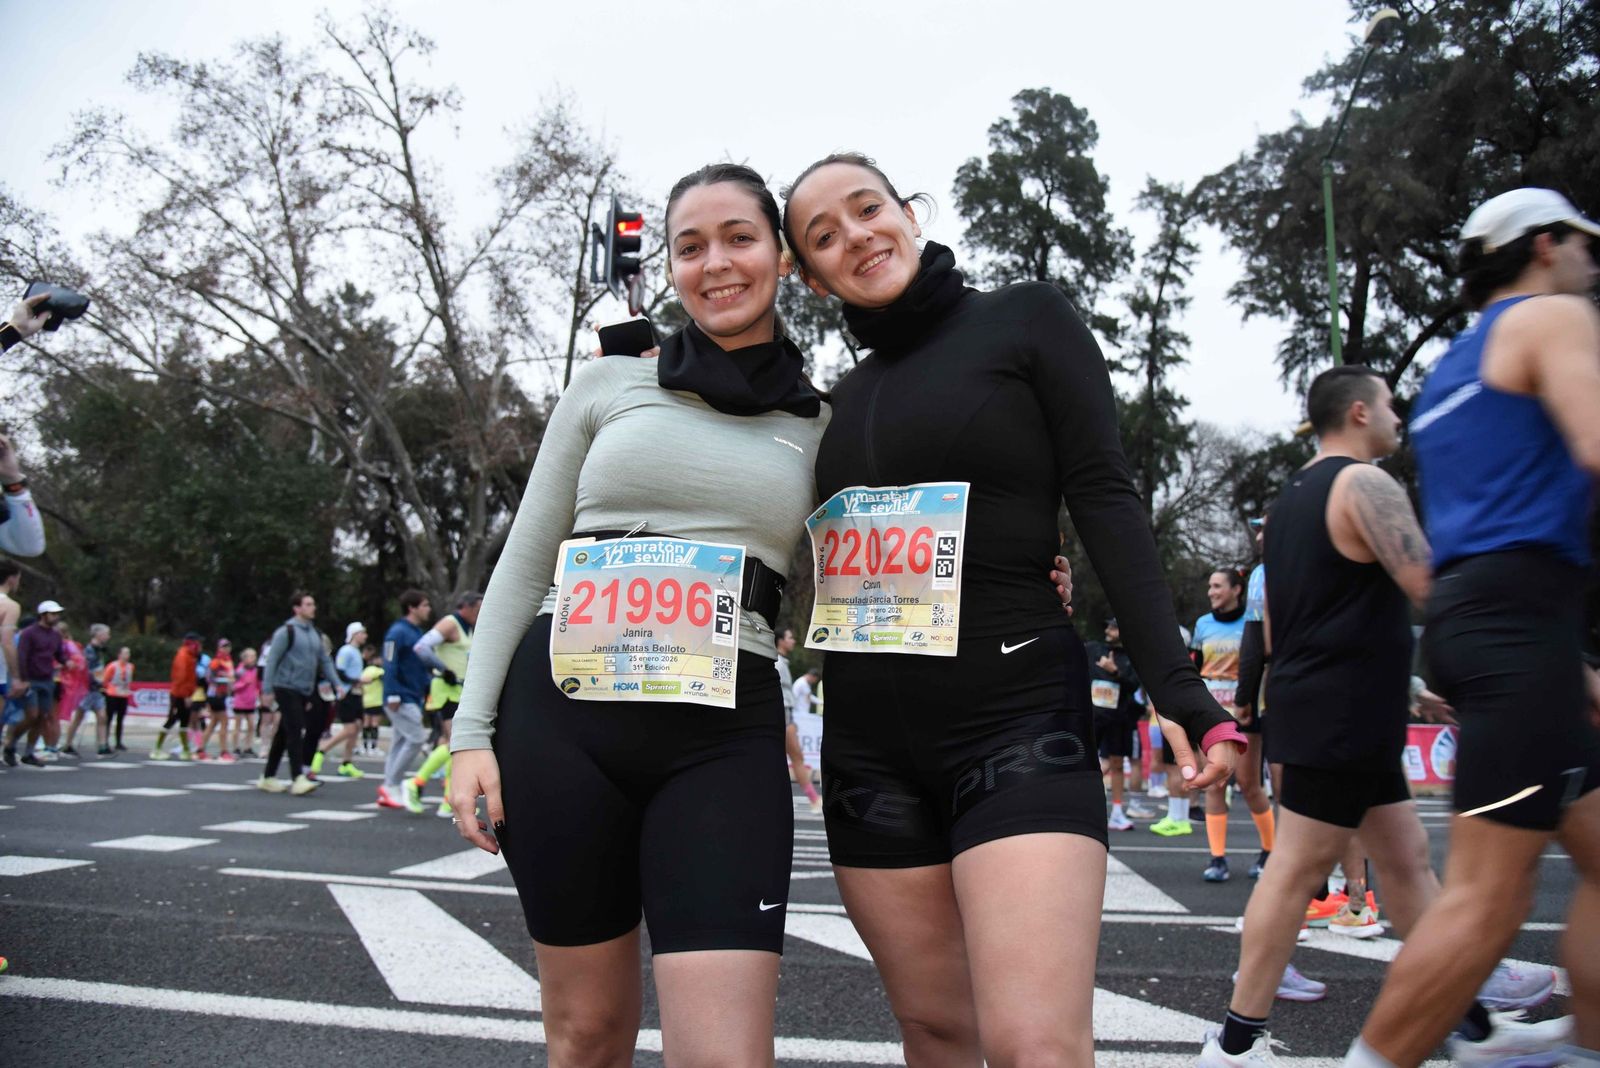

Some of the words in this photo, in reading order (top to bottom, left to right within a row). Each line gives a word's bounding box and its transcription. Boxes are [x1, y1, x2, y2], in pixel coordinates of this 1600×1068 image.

[621, 541, 684, 554] maratón
[824, 526, 934, 576] 22026
[634, 551, 683, 564] sevilla
[567, 577, 713, 627] 21996
[893, 595, 919, 604] Torres
[559, 603, 570, 633] CAJÓN
[622, 628, 653, 638] Janira
[591, 644, 619, 654] Janira
[622, 644, 649, 652] Matas
[652, 644, 686, 653] Belloto
[613, 681, 639, 691] HOKA
[645, 683, 678, 691] Sprinter
[952, 730, 1086, 816] PRO
